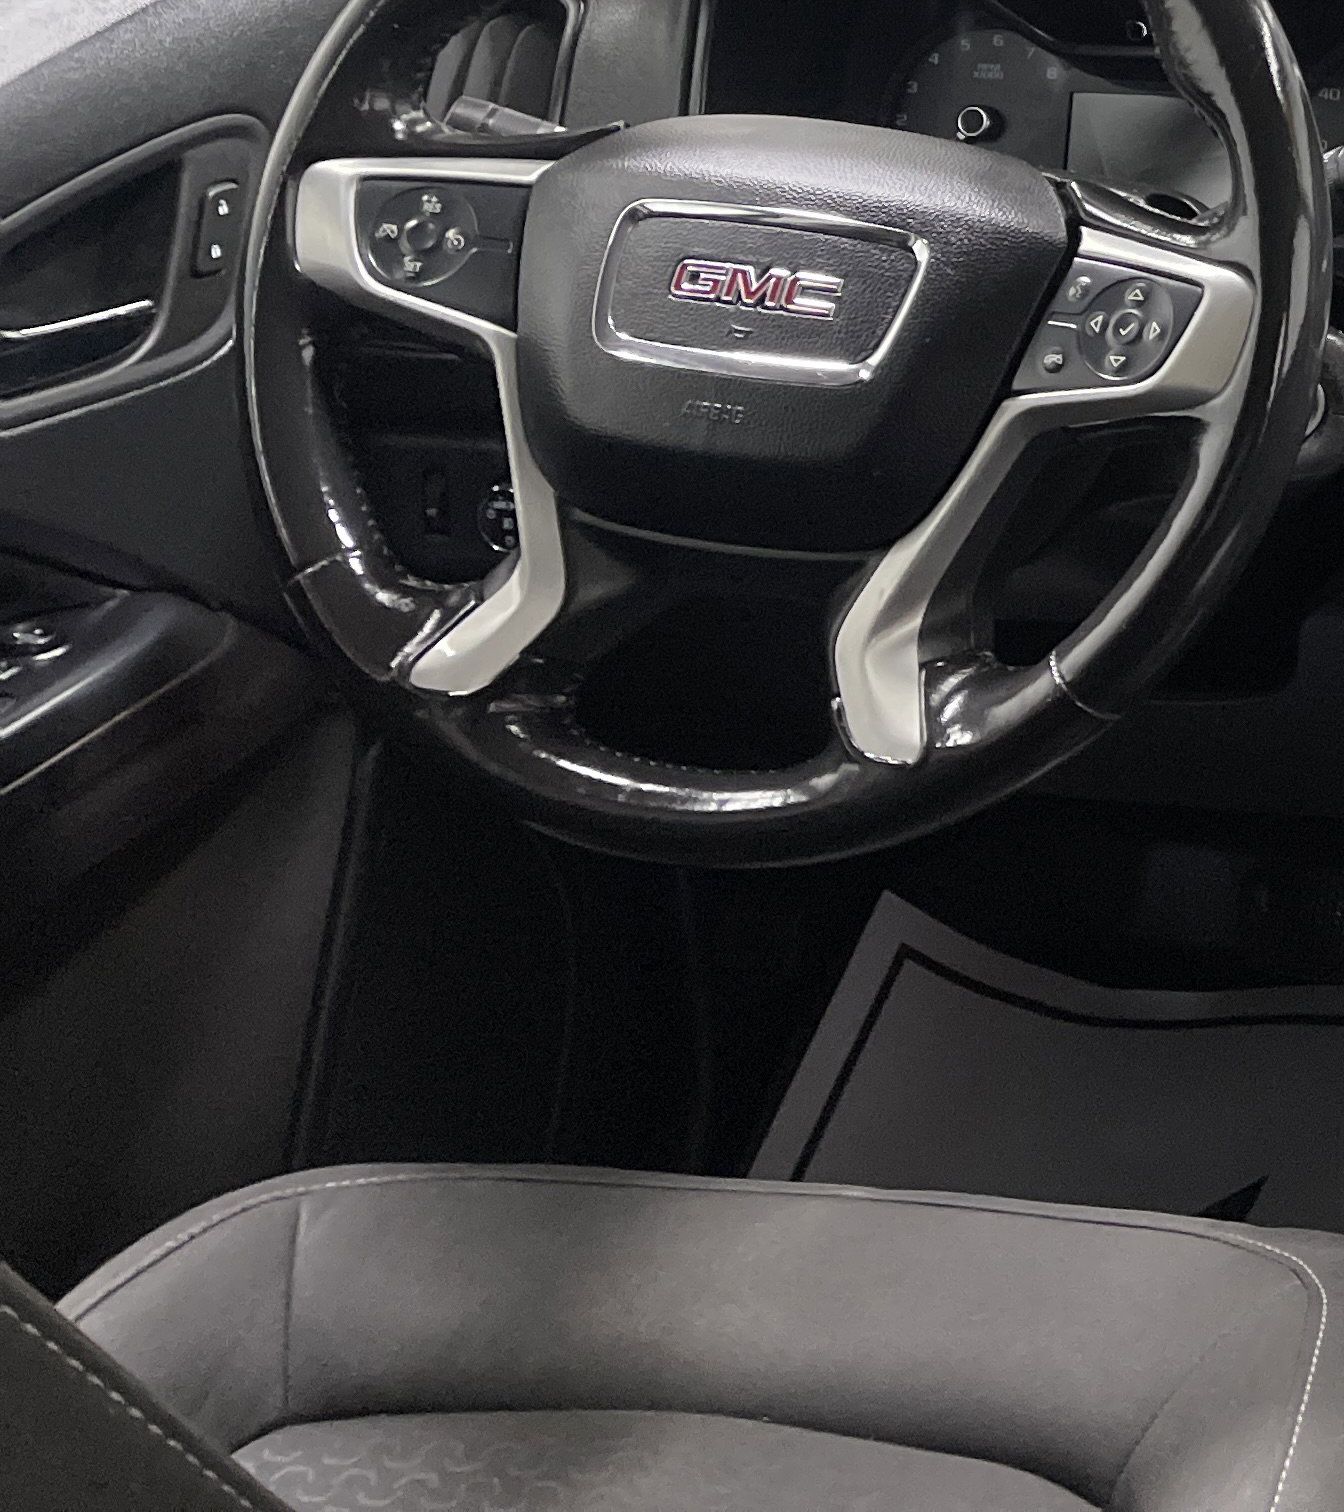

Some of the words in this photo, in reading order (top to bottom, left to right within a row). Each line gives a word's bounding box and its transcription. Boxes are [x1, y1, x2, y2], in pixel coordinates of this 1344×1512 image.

[959, 38, 971, 51] 5
[992, 34, 1004, 47] 6
[928, 52, 940, 65] 4
[1045, 66, 1057, 80] 8
[906, 80, 919, 94] 3
[1317, 87, 1341, 101] 40
[668, 257, 844, 321] GMC
